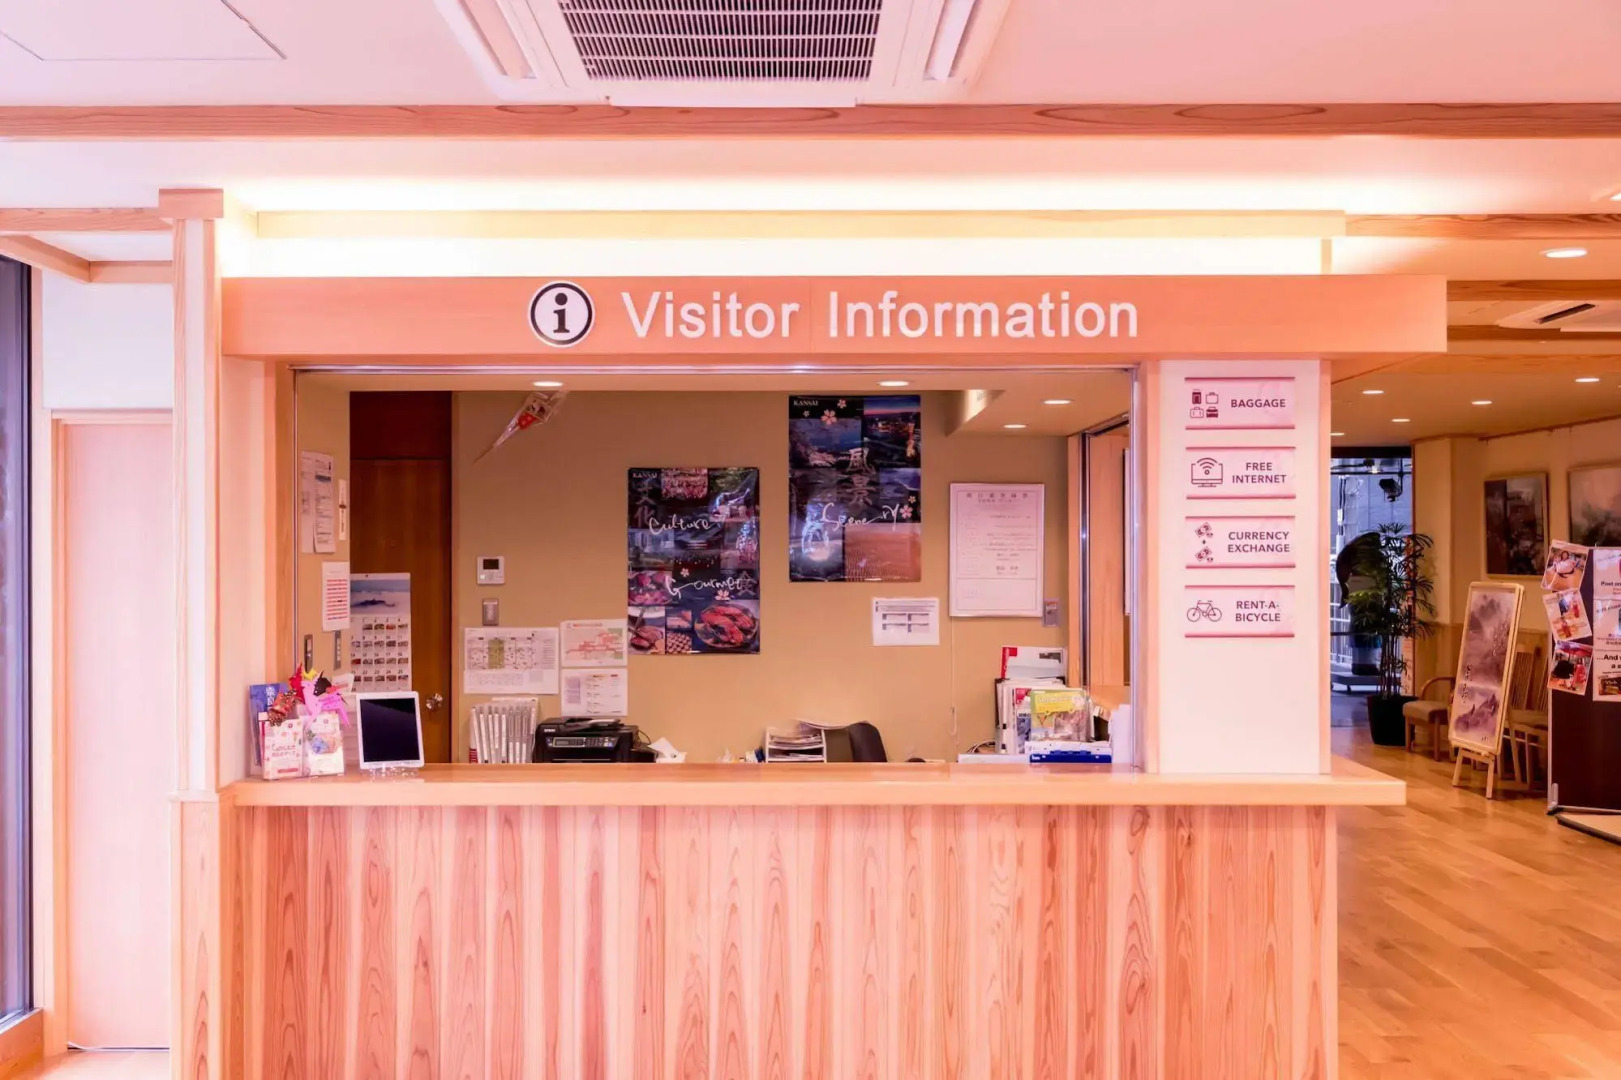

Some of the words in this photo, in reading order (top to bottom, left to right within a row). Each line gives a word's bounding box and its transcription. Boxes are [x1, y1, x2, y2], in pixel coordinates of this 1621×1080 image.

[621, 290, 801, 339] Visitor
[829, 290, 1138, 338] Information
[1230, 398, 1286, 409] BAGGAGE
[1245, 462, 1273, 472] FREE
[1231, 474, 1287, 484] INTERNET
[648, 513, 714, 535] Culture
[1228, 531, 1290, 541] CURRENCY
[1227, 543, 1290, 554] EXCHANGE
[665, 575, 743, 599] Gourmet
[1235, 600, 1280, 610] RENT-A-
[1235, 612, 1281, 623] BICYCLE
